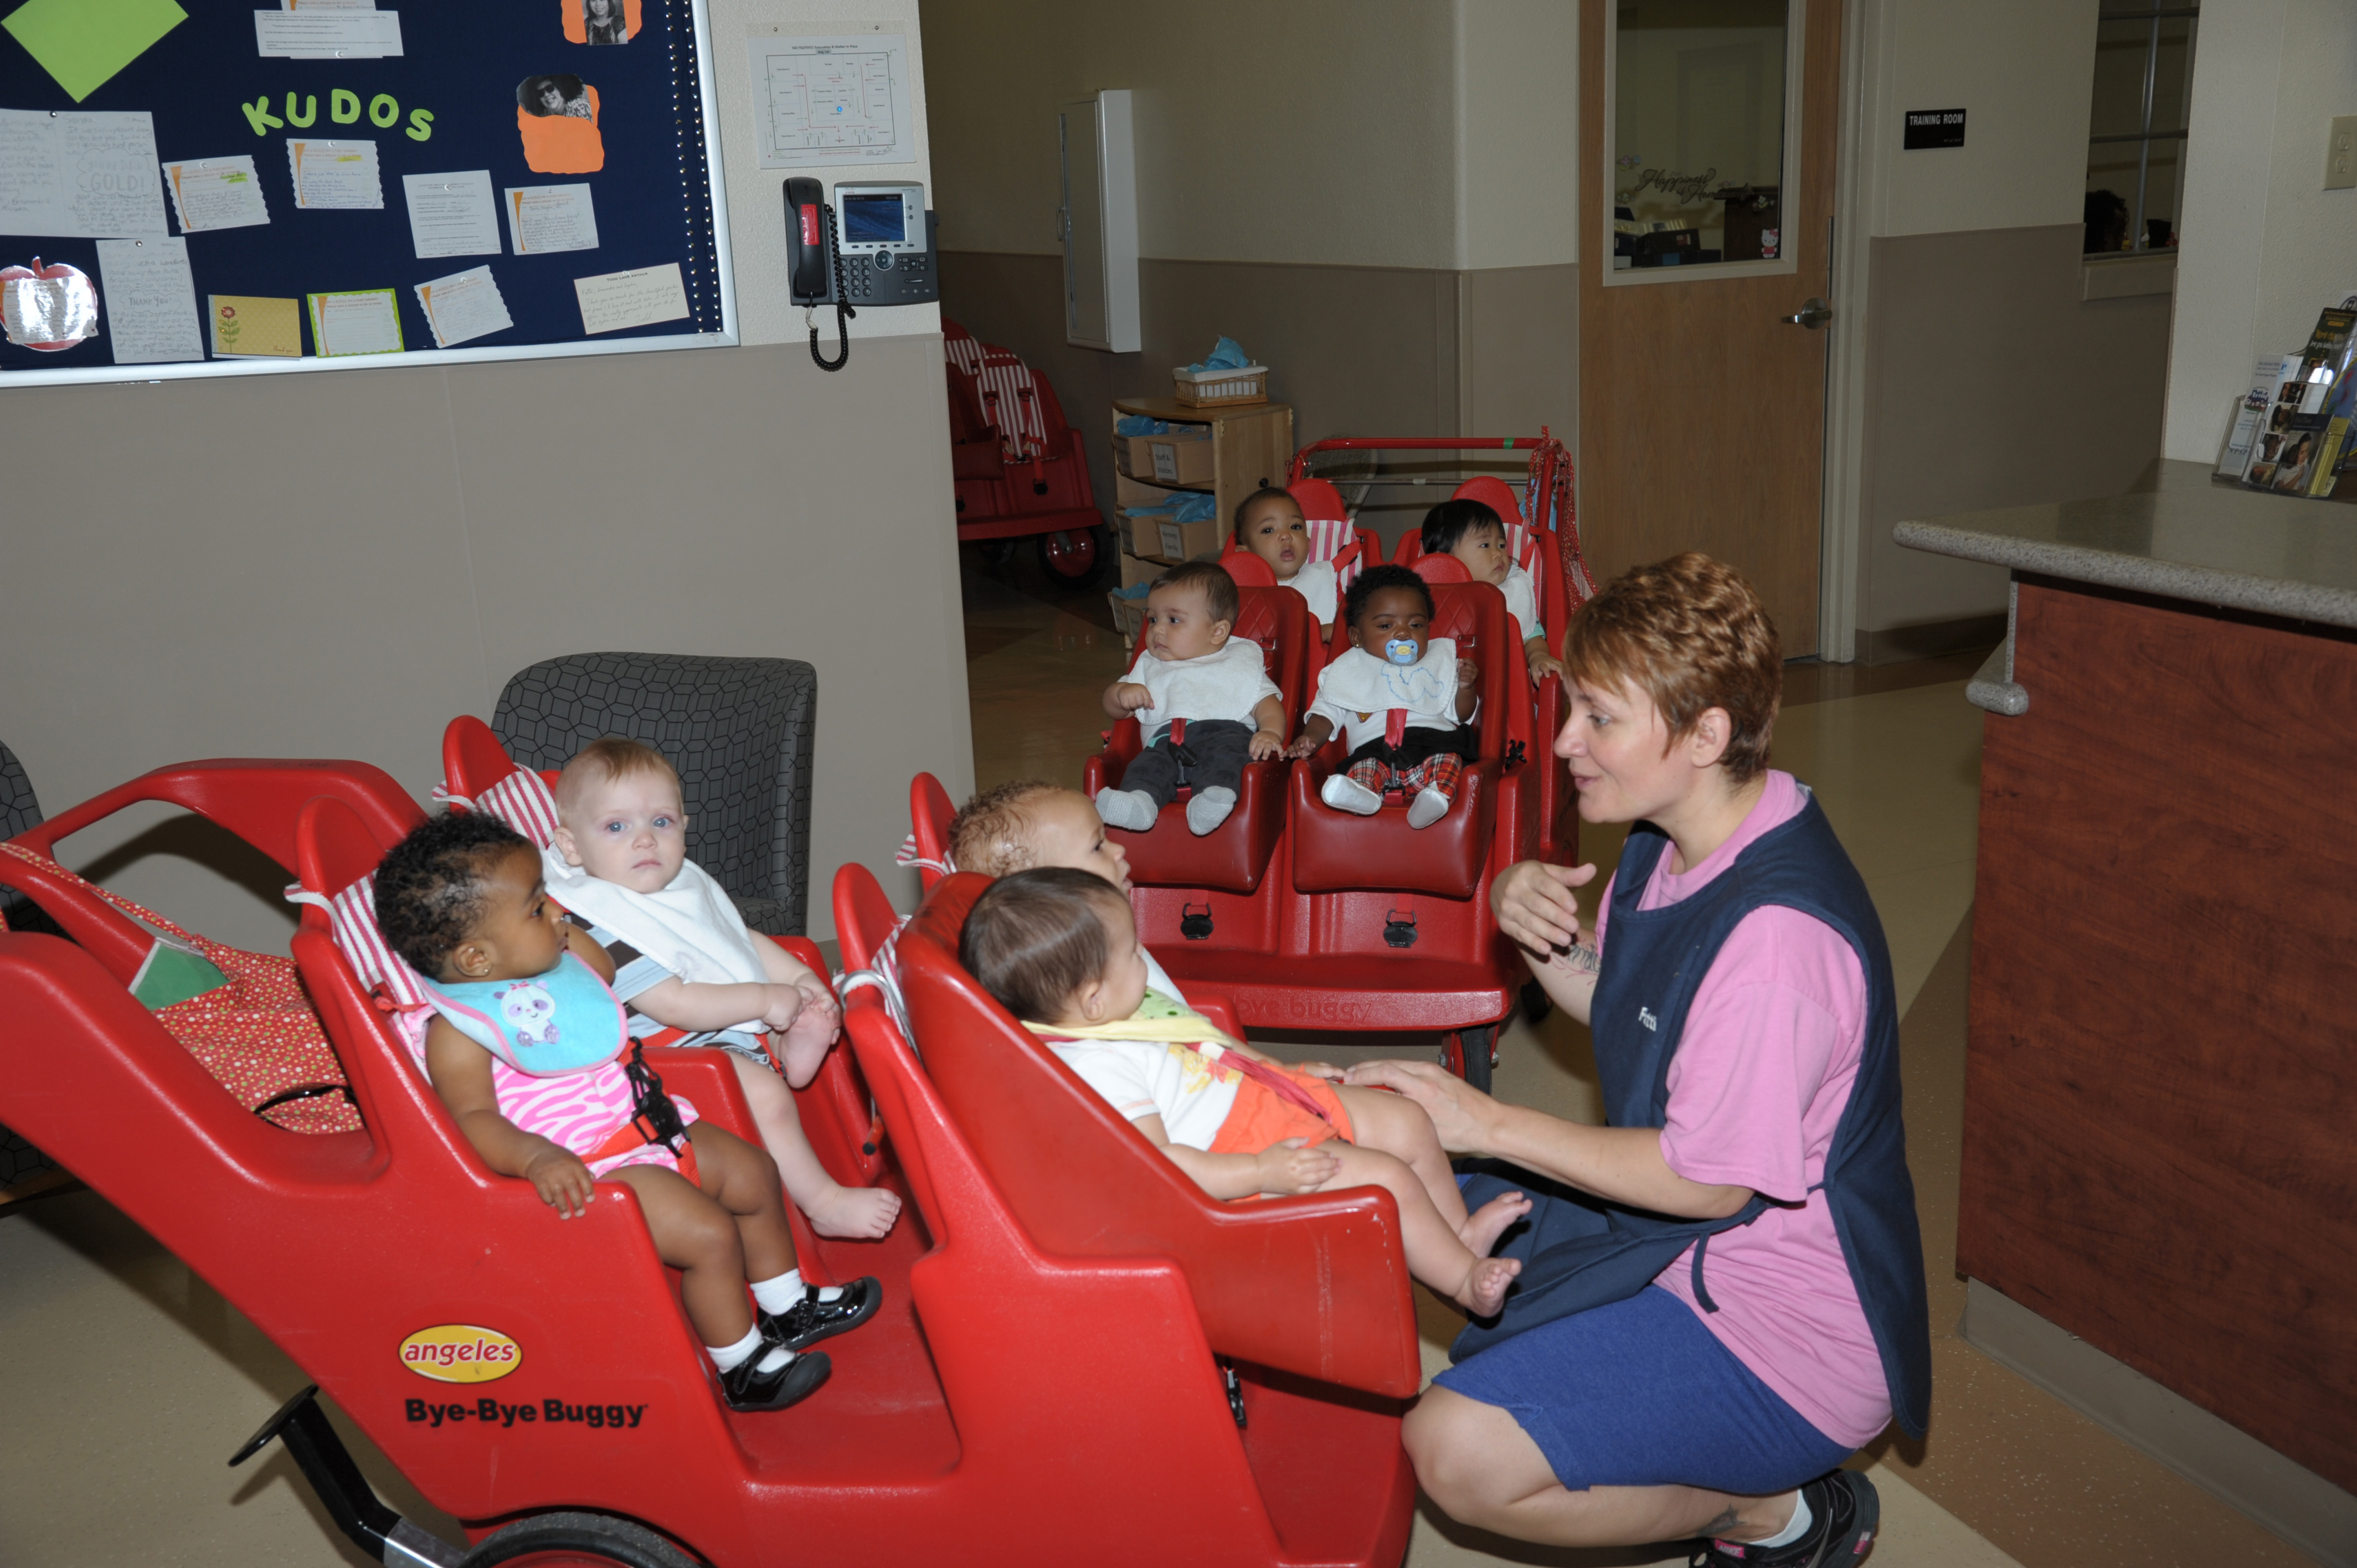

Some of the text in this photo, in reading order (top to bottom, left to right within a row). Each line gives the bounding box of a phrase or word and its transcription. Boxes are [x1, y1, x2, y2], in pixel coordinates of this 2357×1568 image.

[242, 89, 434, 141] KUDOS
[1910, 113, 1963, 126] TRAINING ROOM
[91, 172, 144, 192] GOLD!
[1635, 168, 1716, 192] Happiness
[1676, 187, 1685, 195] is
[1165, 543, 1179, 553] Family
[1289, 996, 1372, 1024] buggy
[404, 1338, 515, 1367] angeles
[405, 1398, 644, 1428] Bye-Bye Buggy
[1718, 1544, 1742, 1556] NIKE
